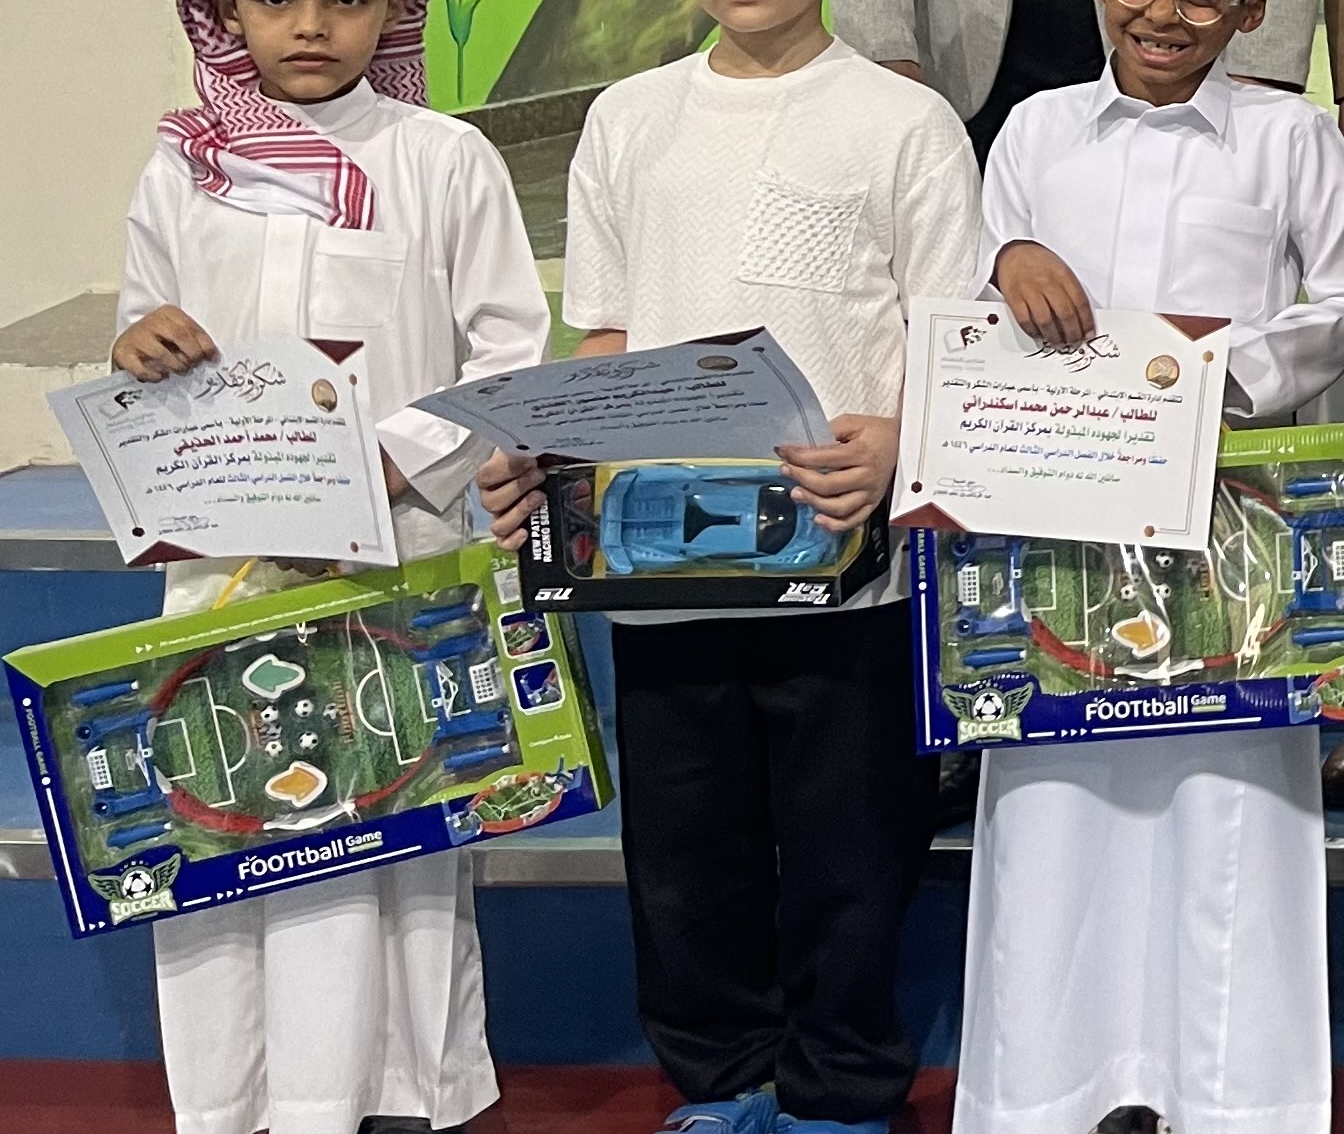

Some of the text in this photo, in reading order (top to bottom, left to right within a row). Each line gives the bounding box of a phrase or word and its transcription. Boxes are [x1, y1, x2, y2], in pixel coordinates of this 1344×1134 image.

[1020, 401, 1047, 412] محمد
[960, 418, 991, 431] الكريم
[1120, 409, 1157, 423] للطالب
[253, 432, 277, 442] محمد
[1024, 422, 1052, 438] بمركز
[541, 527, 553, 562] RACING
[1085, 693, 1227, 721] FOOTtball Game
[959, 718, 1020, 738] SOCCER
[238, 830, 383, 881] FOOTtball Game
[111, 893, 174, 918] SOCCER
